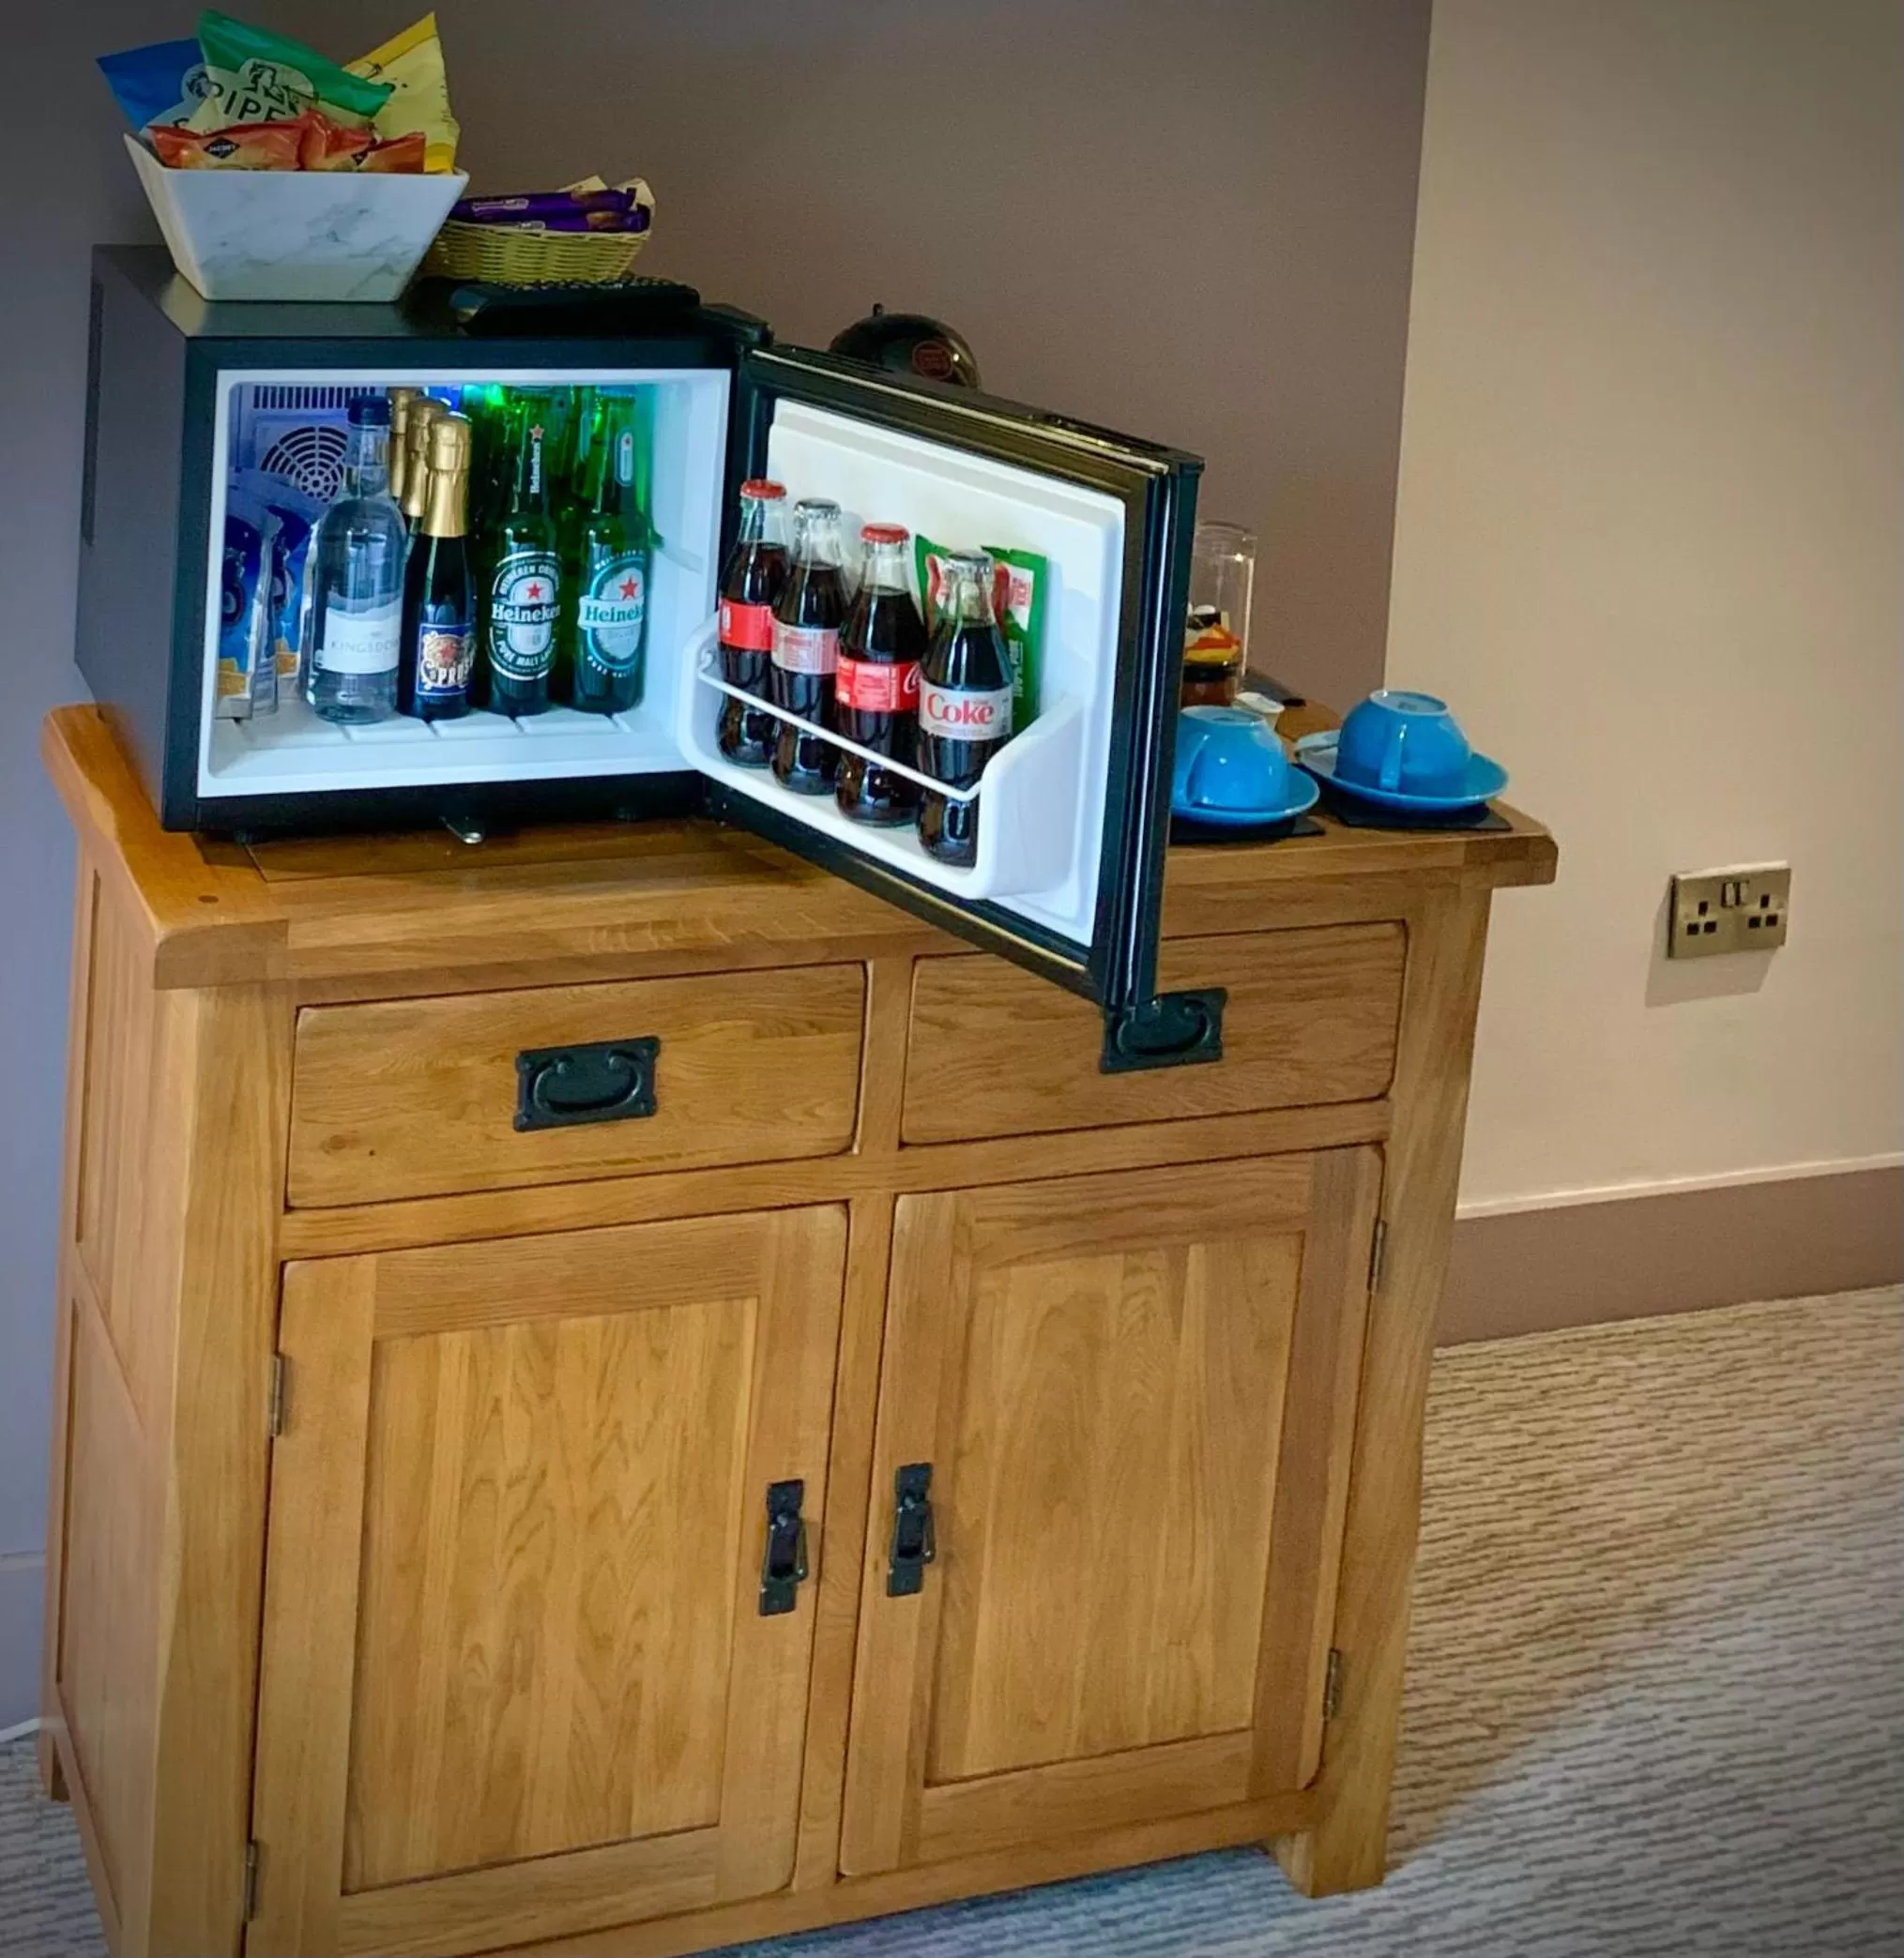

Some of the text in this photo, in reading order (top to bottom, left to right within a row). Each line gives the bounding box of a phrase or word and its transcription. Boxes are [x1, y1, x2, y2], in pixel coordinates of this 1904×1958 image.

[208, 82, 286, 121] PIPE
[492, 603, 560, 621] Heineken
[929, 692, 995, 724] Coke
